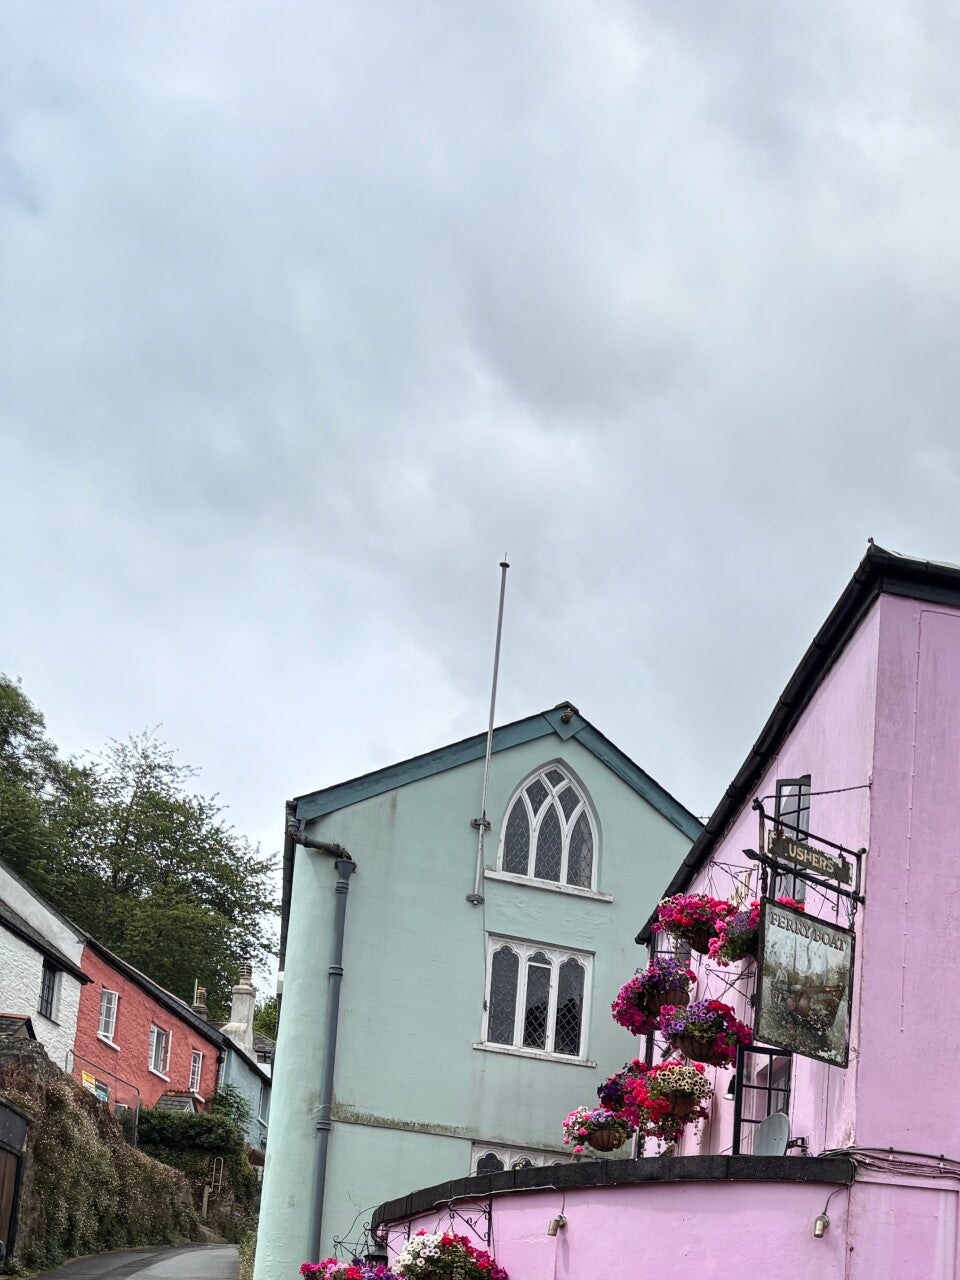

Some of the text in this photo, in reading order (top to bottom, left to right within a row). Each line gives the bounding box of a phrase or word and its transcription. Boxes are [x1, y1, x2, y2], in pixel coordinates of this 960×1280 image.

[788, 843, 834, 873] USHERS
[769, 911, 847, 952] FERRY BOAT
